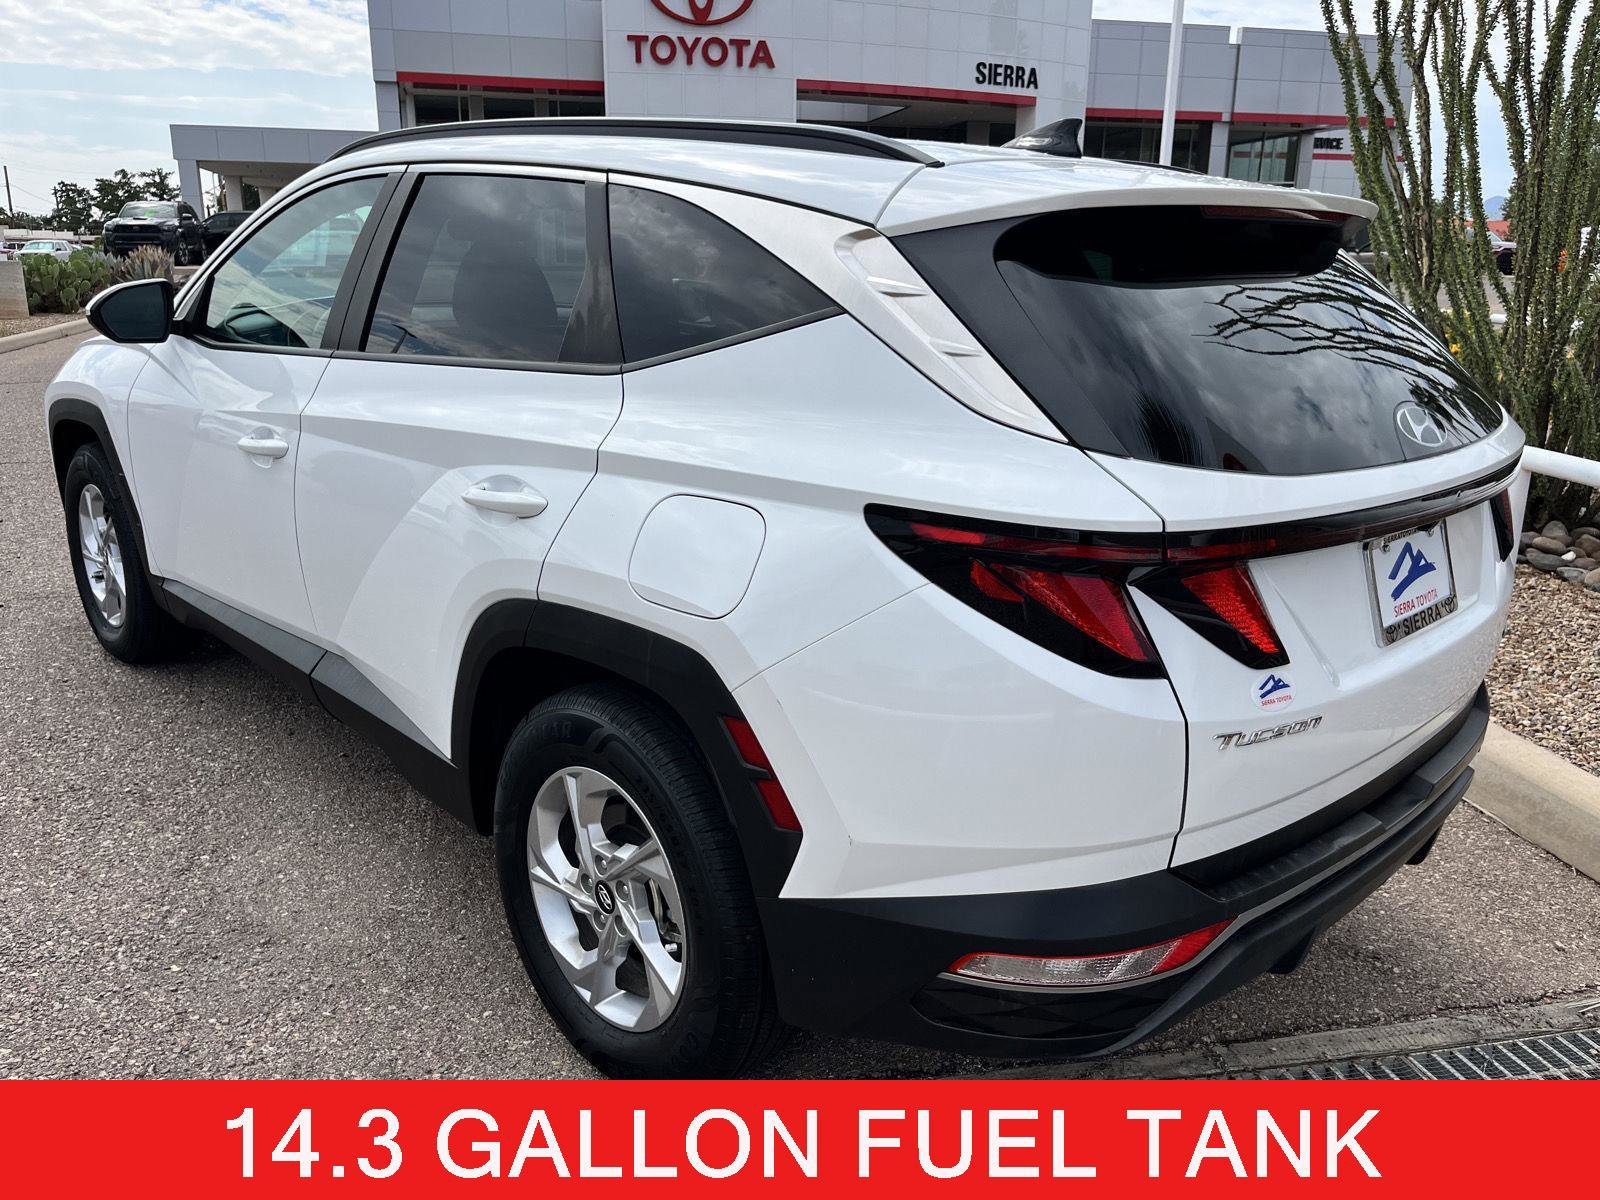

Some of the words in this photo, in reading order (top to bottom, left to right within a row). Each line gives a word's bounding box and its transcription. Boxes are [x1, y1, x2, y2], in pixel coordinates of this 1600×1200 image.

[627, 34, 775, 69] TOYOTA
[975, 61, 1039, 90] SIERRA
[1393, 599, 1416, 618] SIERRA
[1416, 588, 1438, 607] TOYOTA
[1402, 604, 1442, 635] SIERRA
[1261, 698, 1276, 706] SIERRA
[1276, 694, 1292, 703] TOYOTA
